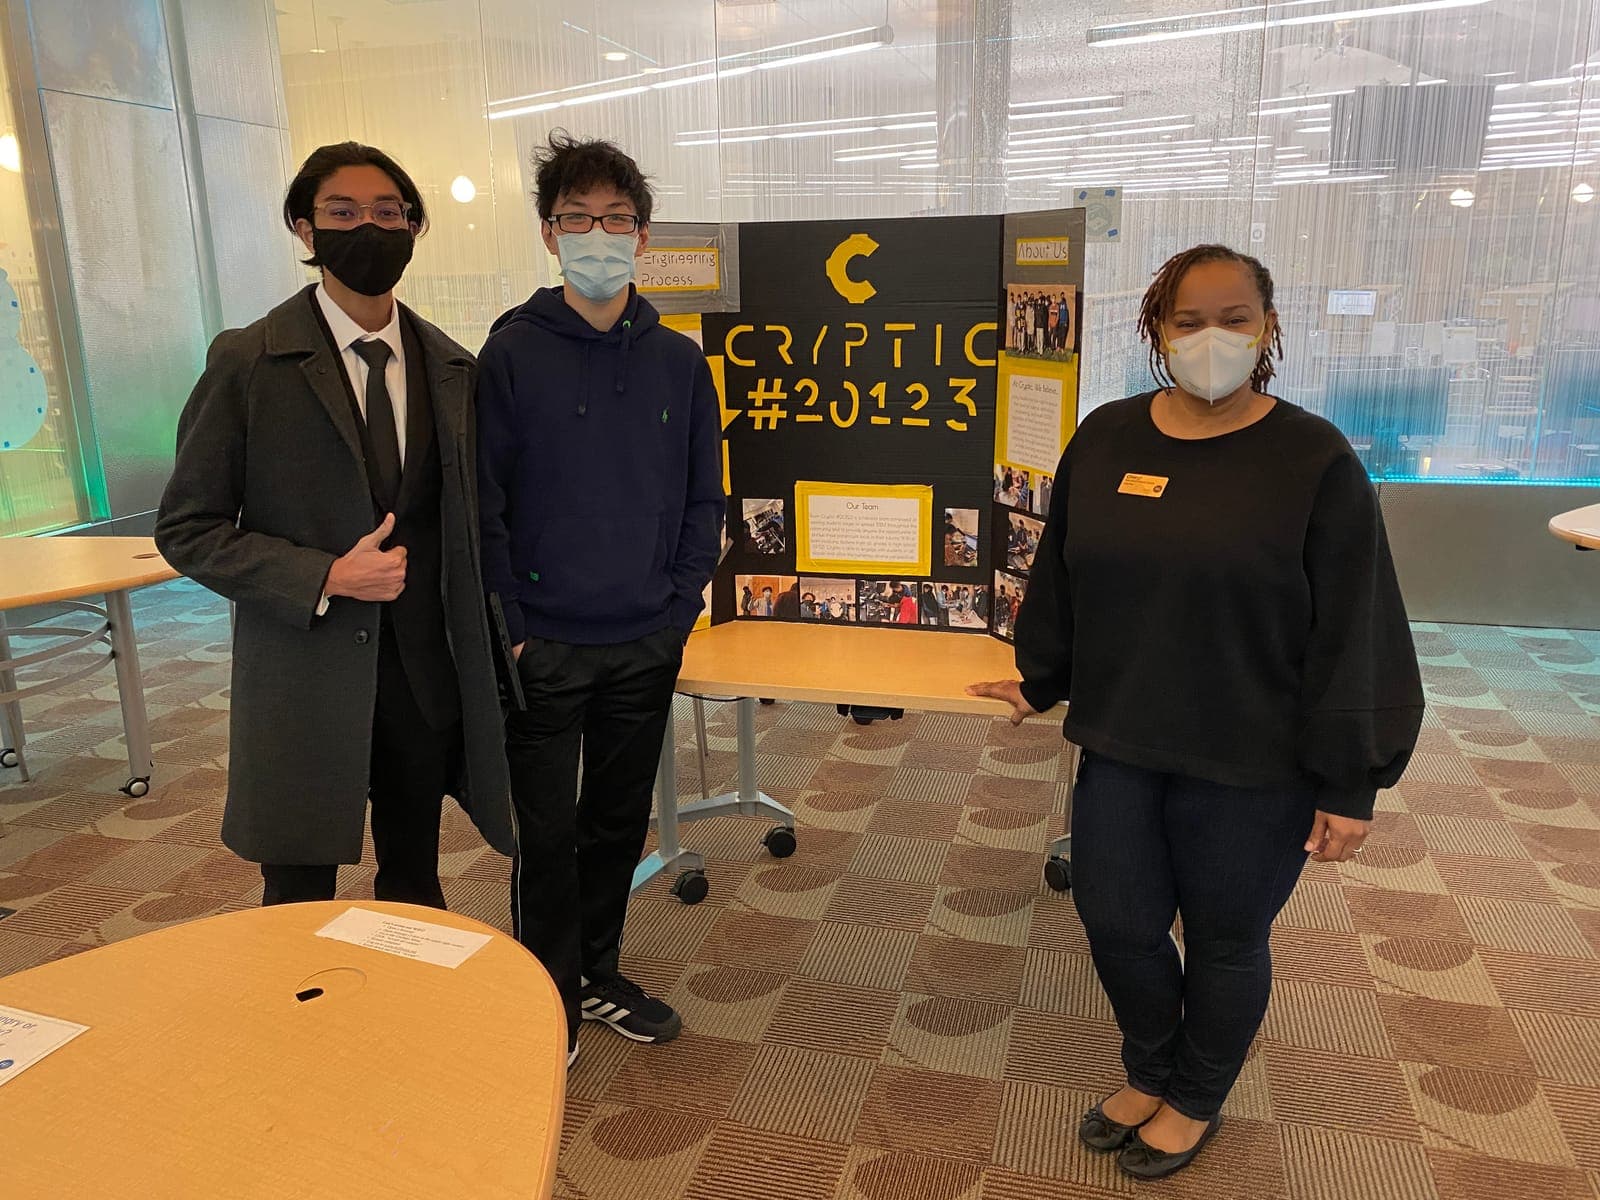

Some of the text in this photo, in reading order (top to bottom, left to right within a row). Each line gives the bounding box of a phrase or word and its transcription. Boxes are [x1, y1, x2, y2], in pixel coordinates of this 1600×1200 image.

[1018, 242, 1067, 259] About Us
[644, 251, 716, 267] Engineering
[641, 273, 693, 286] Process
[725, 321, 998, 368] CRYPTIC
[747, 377, 977, 432] #20123
[846, 502, 879, 511] Our Team
